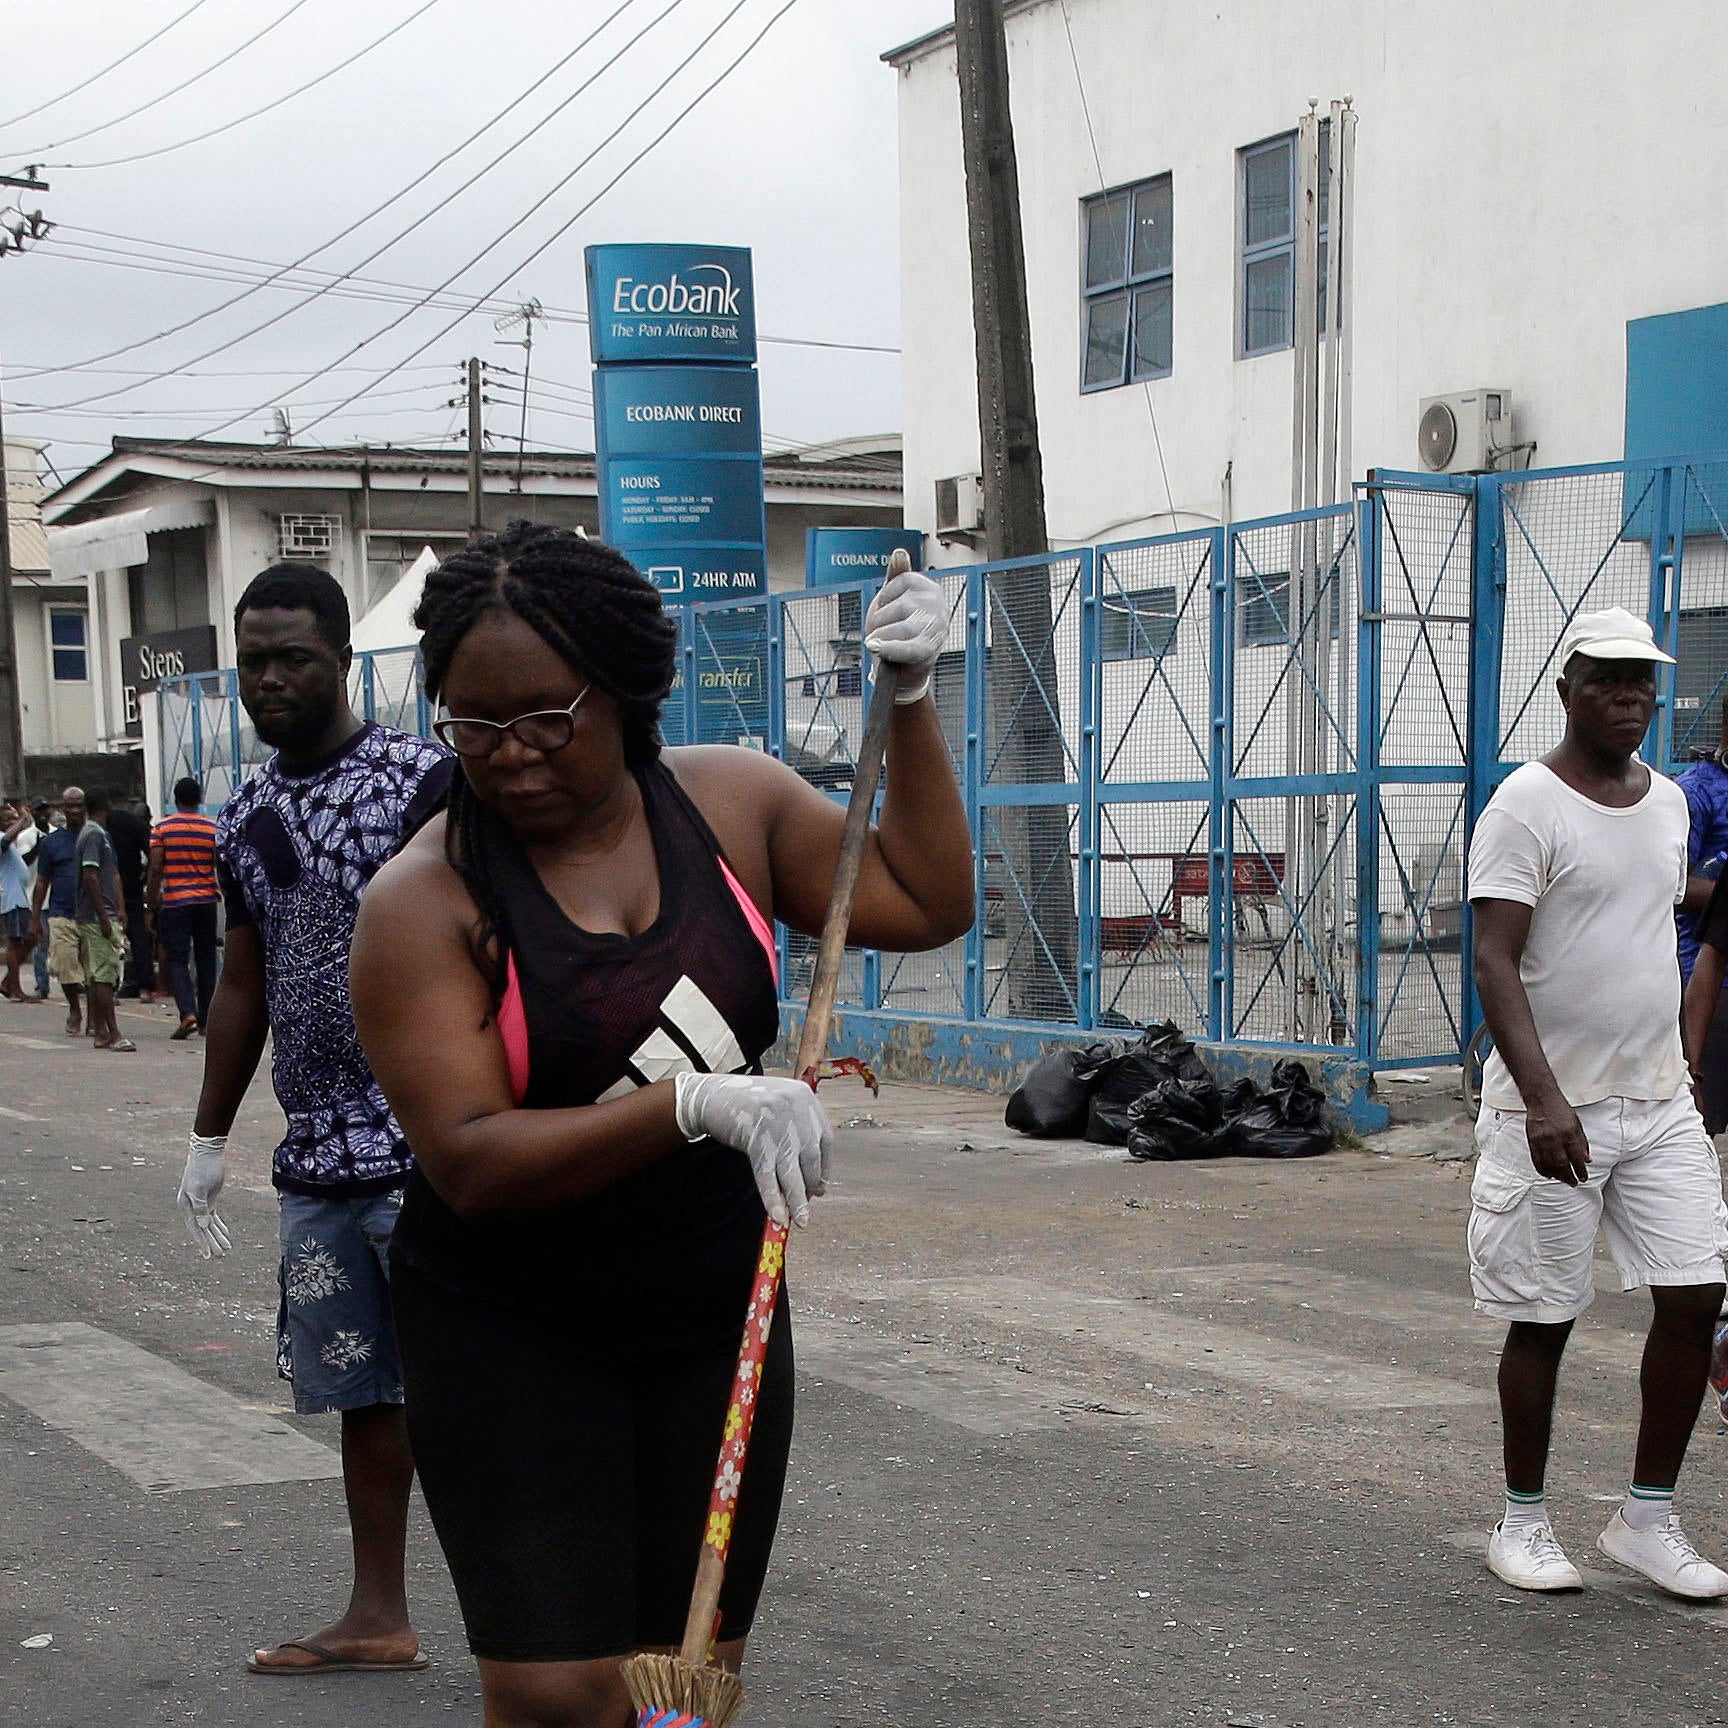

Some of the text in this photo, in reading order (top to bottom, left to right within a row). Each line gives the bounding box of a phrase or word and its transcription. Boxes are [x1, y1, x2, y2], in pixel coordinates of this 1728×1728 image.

[613, 264, 740, 315] Ecobank
[612, 323, 739, 340] The Pan African Bank
[626, 404, 742, 423] ECOBANK DIRECT
[620, 475, 661, 489] HOURS
[831, 554, 878, 567] ECOBANK
[692, 571, 756, 589] 24HR ATM
[140, 645, 185, 680] Steps
